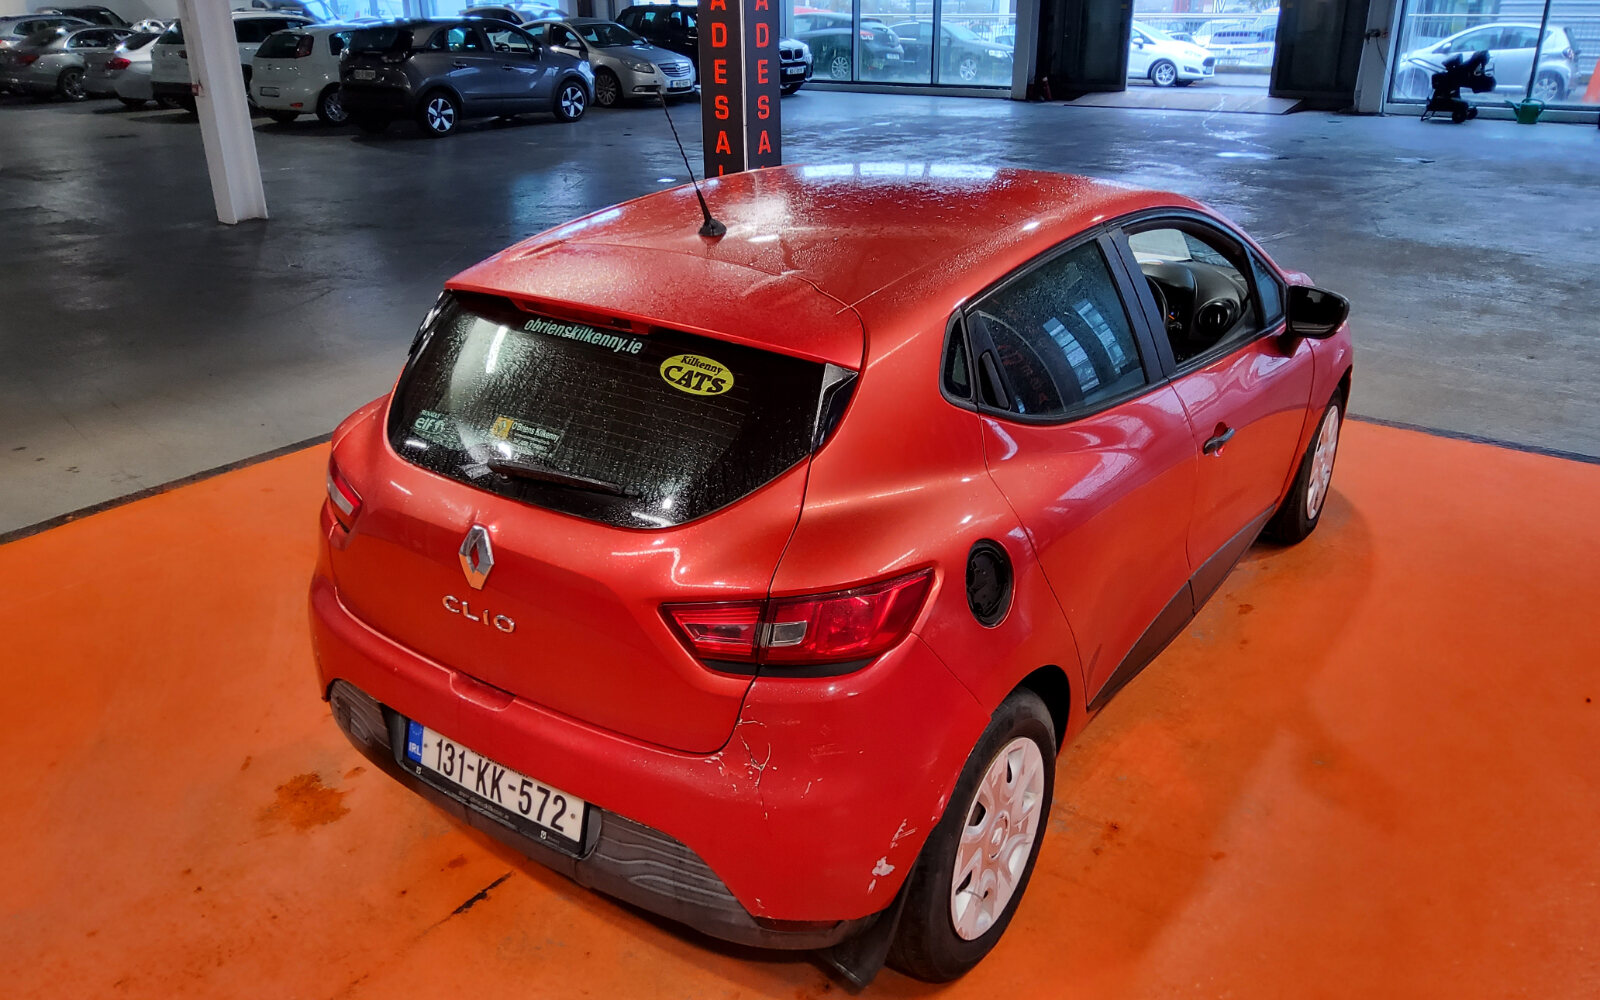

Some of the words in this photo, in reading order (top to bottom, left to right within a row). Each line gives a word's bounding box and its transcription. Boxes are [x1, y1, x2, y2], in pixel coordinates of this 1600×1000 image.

[754, 0, 772, 169] DESA
[523, 317, 643, 354] obrienskilkenny.ie
[663, 365, 727, 393] CATS
[680, 355, 724, 376] Kilkenny
[441, 595, 515, 633] CLIO
[408, 741, 422, 757] IRL
[436, 738, 568, 832] 131-KK-572
